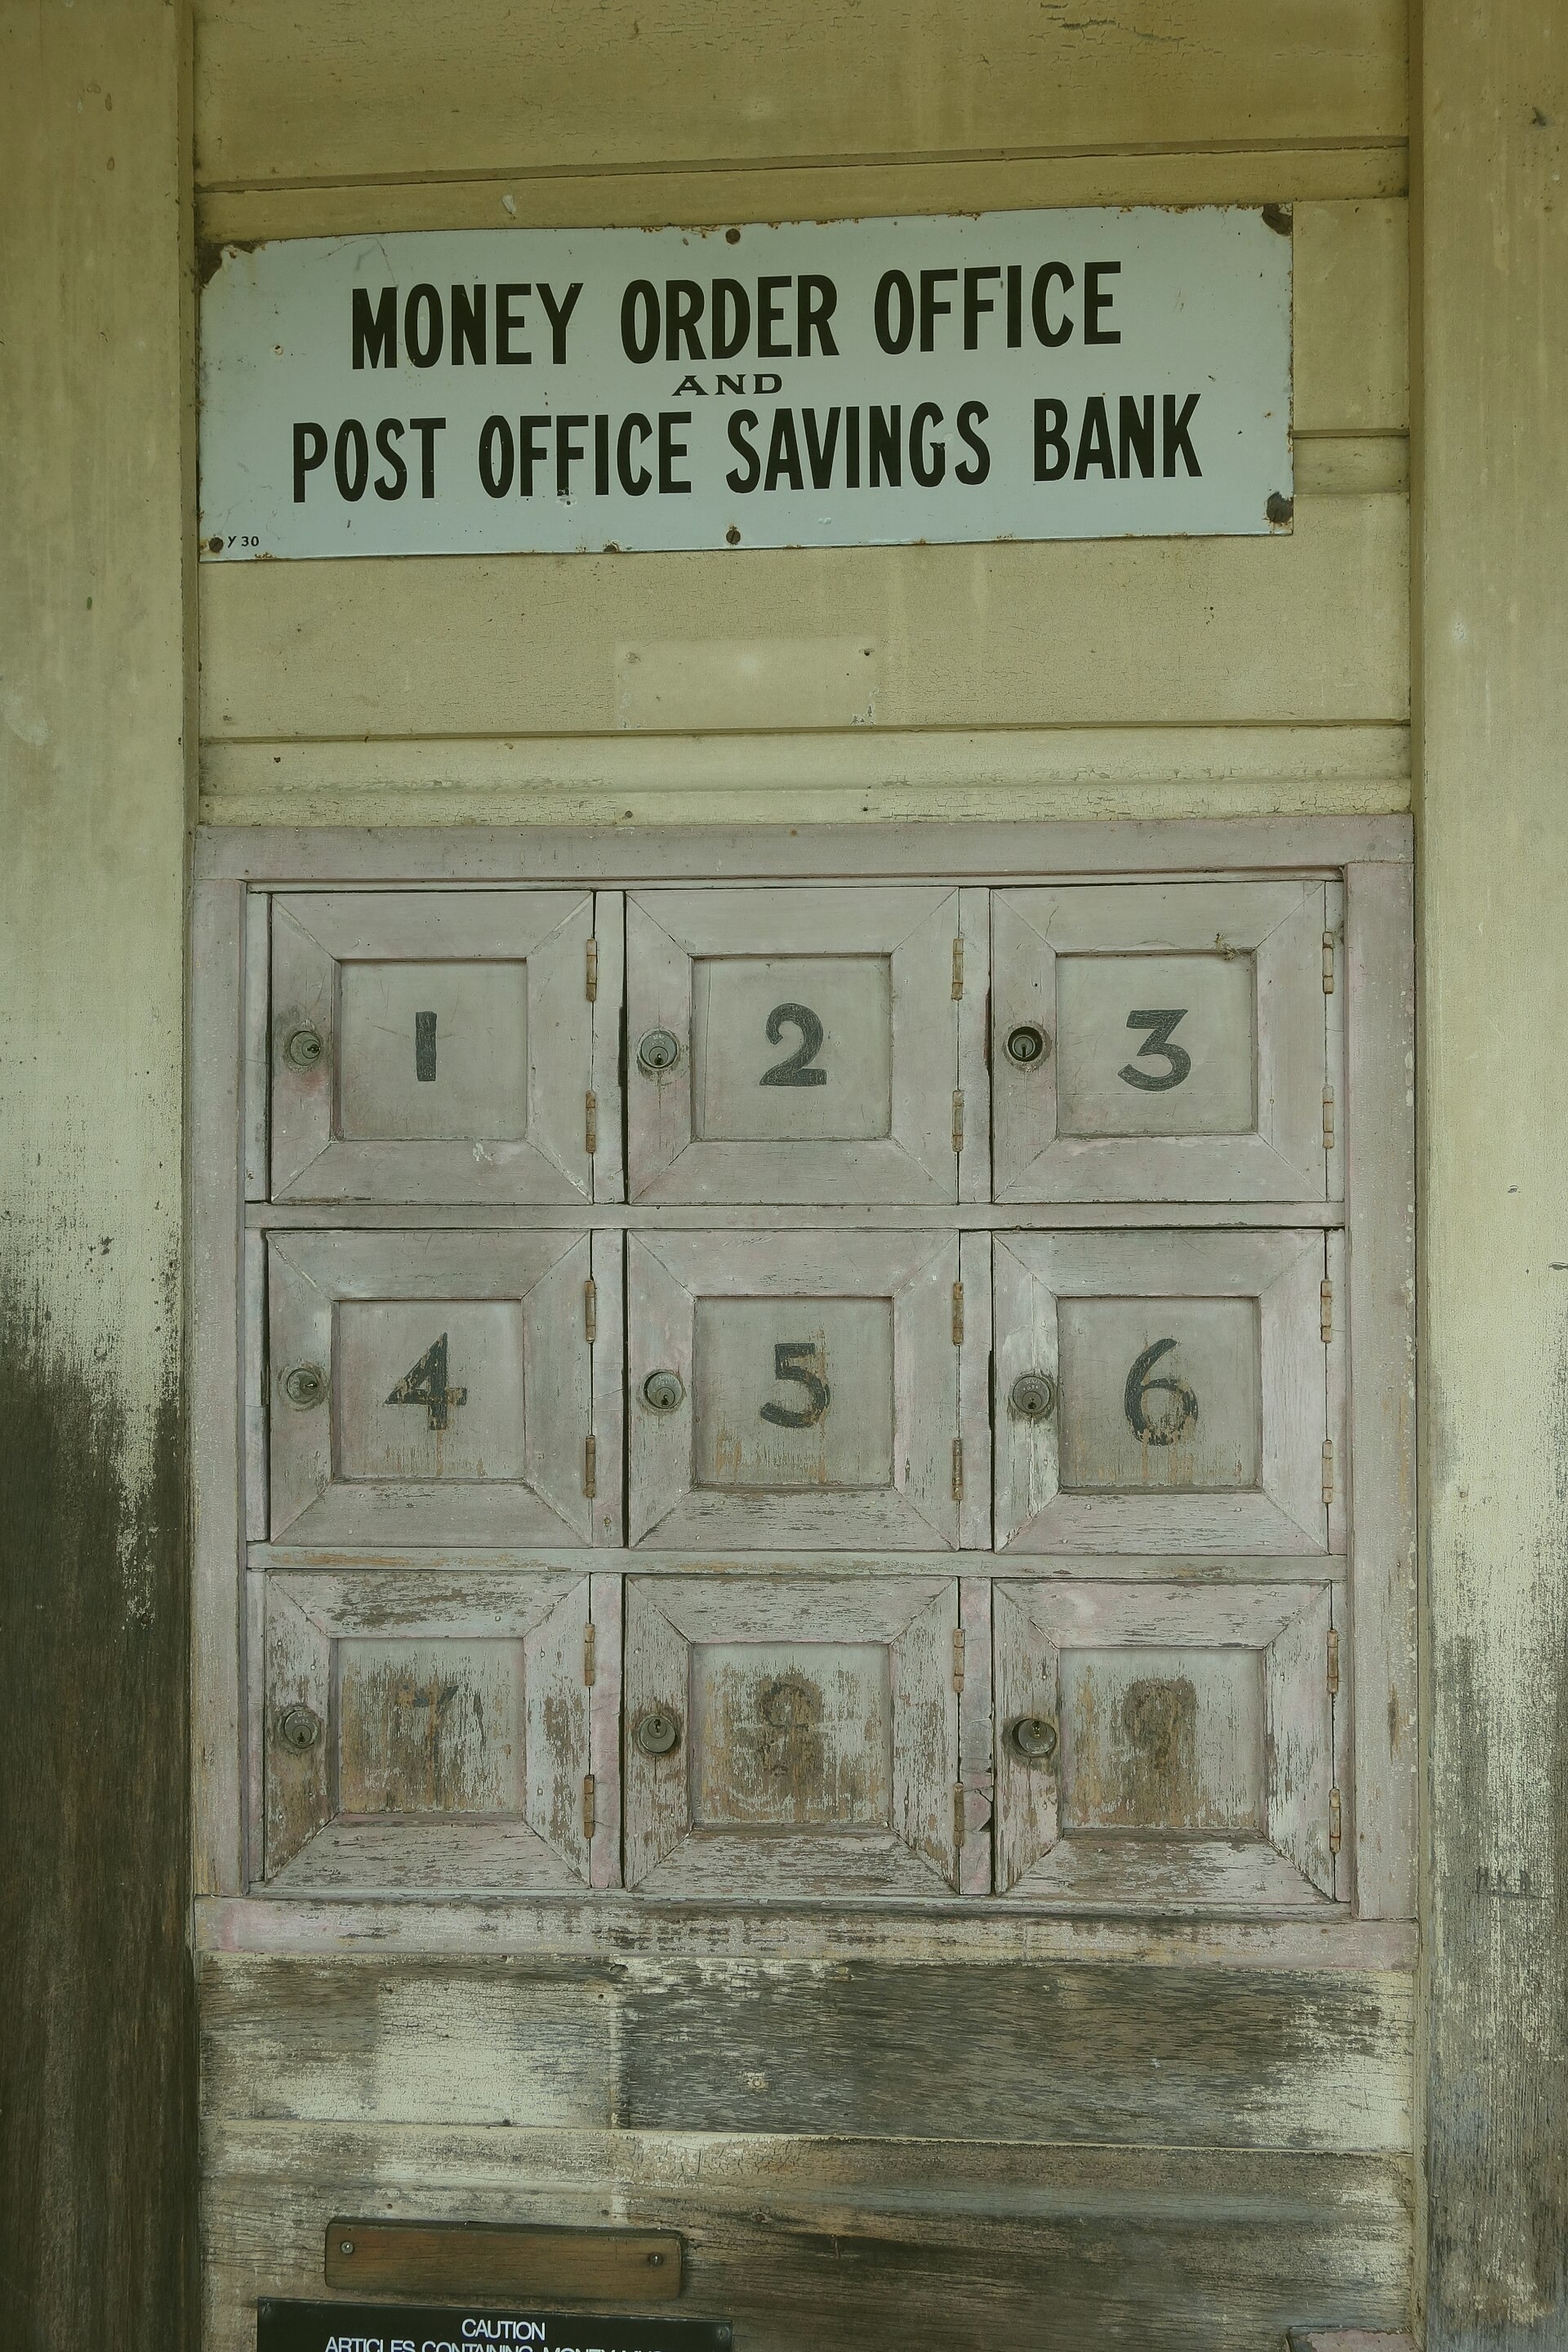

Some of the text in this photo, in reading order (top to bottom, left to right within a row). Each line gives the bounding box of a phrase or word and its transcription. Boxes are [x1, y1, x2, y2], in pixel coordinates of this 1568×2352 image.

[353, 261, 1120, 369] MONEY ORDER OFFICE
[671, 374, 782, 396] AND
[293, 394, 1202, 502] POST OFFICE SAVINGS BANK
[242, 537, 259, 546] 30
[416, 1011, 437, 1081] 1
[759, 1003, 826, 1087] 2
[1117, 1009, 1191, 1092] 3
[383, 1333, 467, 1432] 4
[760, 1343, 831, 1429] 5
[1125, 1339, 1199, 1447] 6
[325, 2336, 415, 2352] ARTICLES
[461, 2319, 546, 2341] CAUTION
